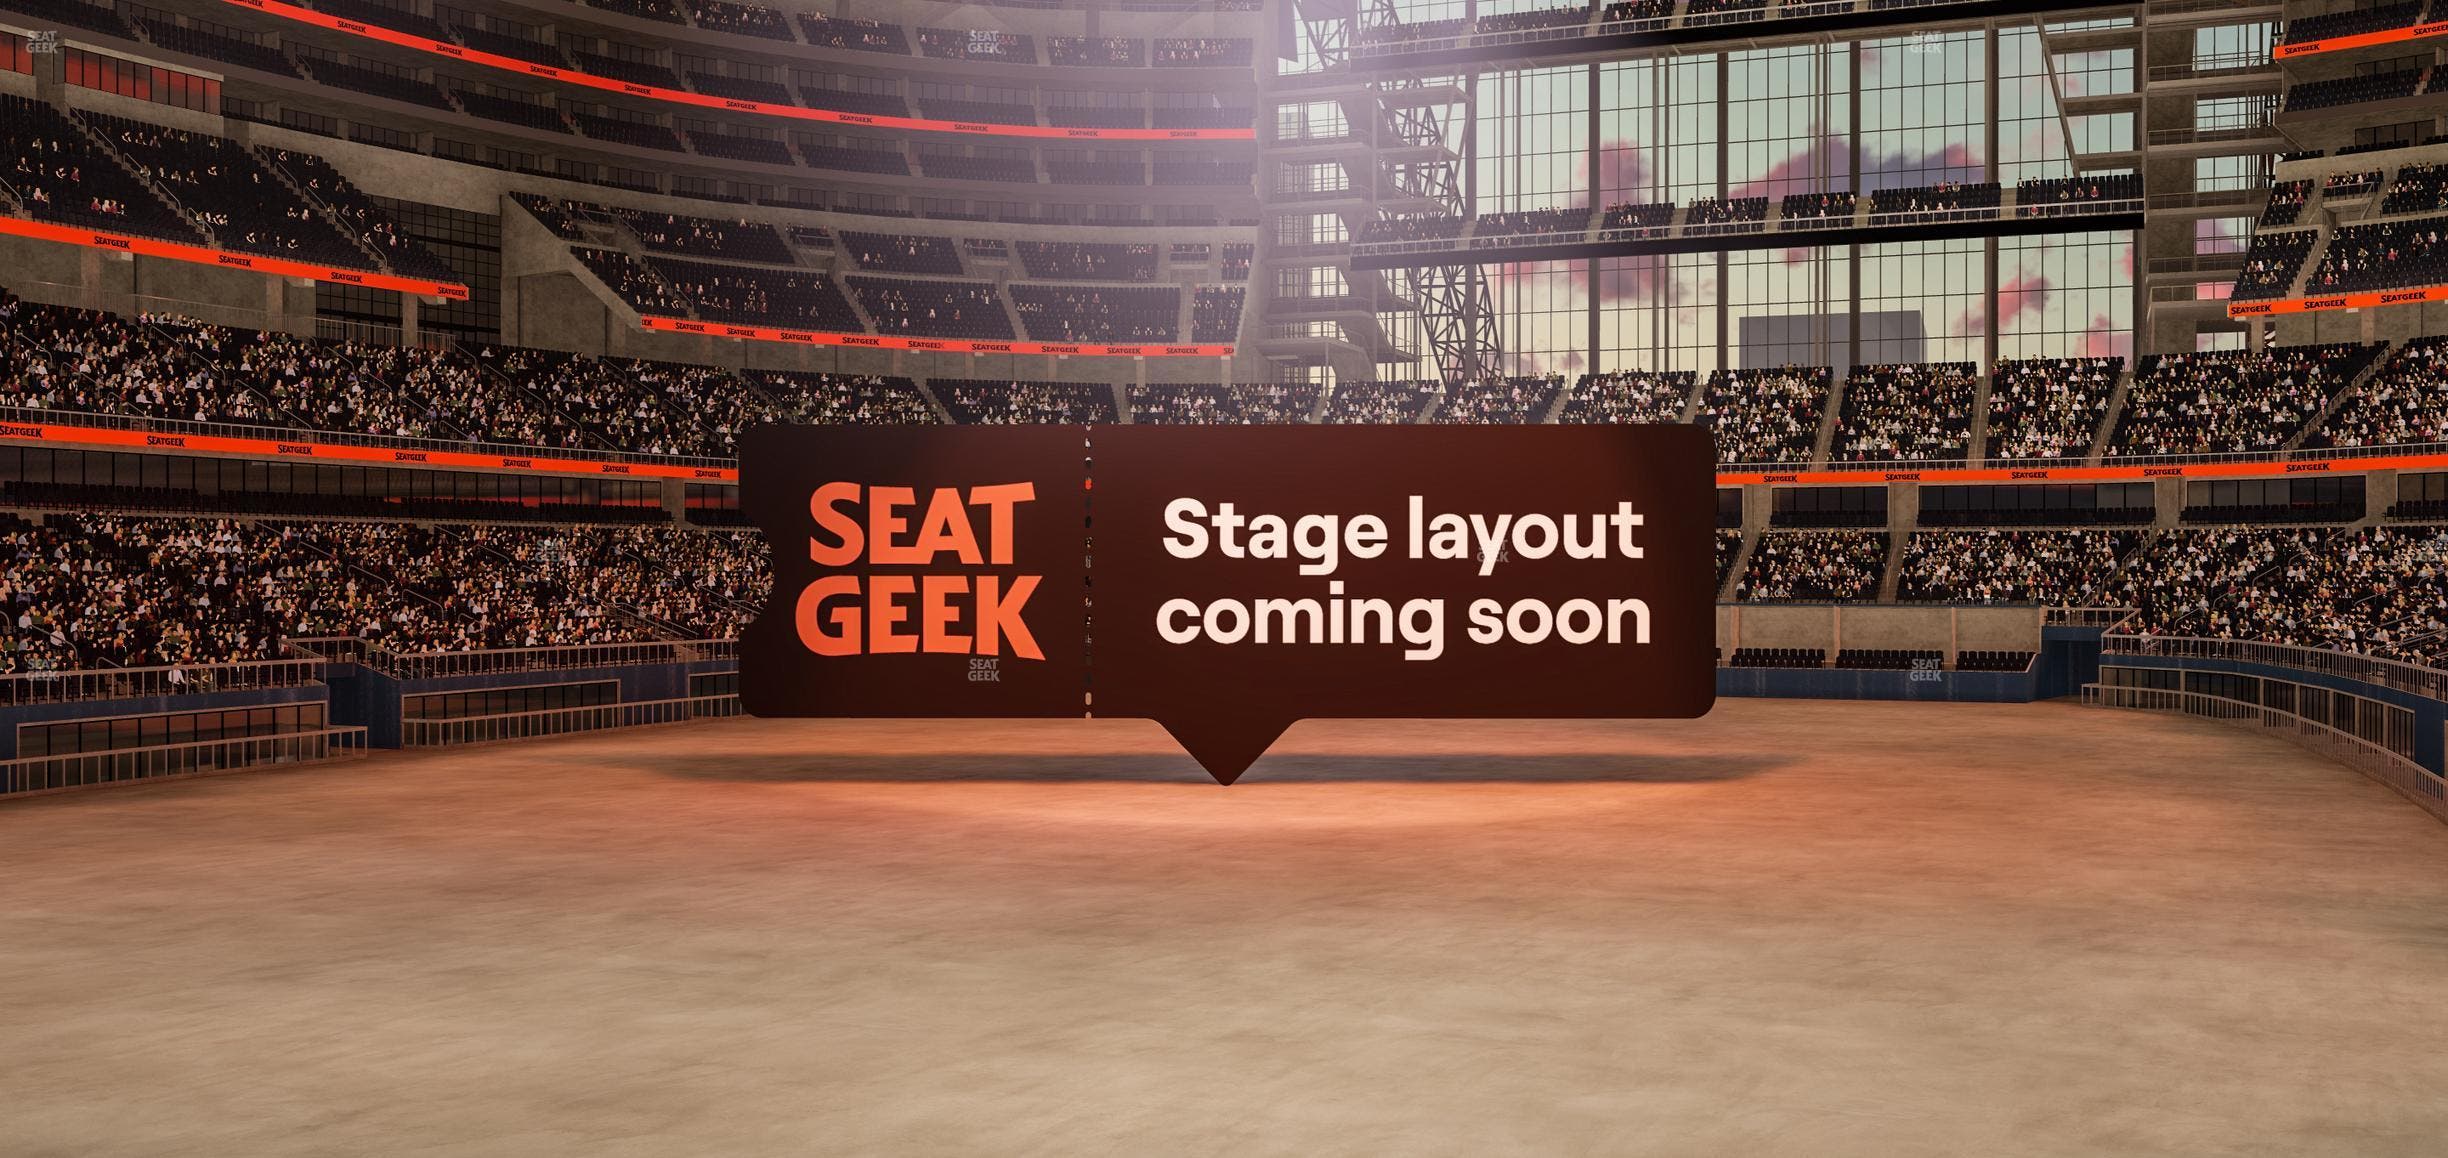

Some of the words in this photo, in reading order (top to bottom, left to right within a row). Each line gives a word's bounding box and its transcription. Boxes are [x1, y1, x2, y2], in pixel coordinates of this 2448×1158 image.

[337, 20, 366, 33] SEATGEEK
[436, 45, 462, 56] SEATGEEK
[2284, 44, 2320, 54] SEATGEEK
[530, 65, 557, 76] SEATGEEK
[624, 84, 651, 95] SEATGEEK
[726, 101, 757, 110] SEATGEEK
[839, 114, 872, 123] SEATGEEK
[94, 236, 129, 249] SEATGEEK
[219, 255, 251, 267] SEATGEEK
[331, 273, 362, 283] SEATGEEK
[438, 287, 466, 298] SEATGEEK
[2381, 292, 2426, 303] SEATGEEK
[2231, 303, 2271, 314] SEATGEEK
[2304, 299, 2346, 310] SEATGEEK
[675, 322, 704, 332] SEATGEEK
[727, 328, 755, 338] SEATGEEK
[780, 332, 812, 342] SEATGEEK
[842, 337, 879, 346] SEATGEEK
[971, 343, 1010, 352] SEATGEEK
[1041, 345, 1079, 354] SEATGEEK
[1107, 347, 1141, 355] SEATGEEK
[147, 434, 184, 447] SEATGEEK
[278, 445, 312, 456] SEATGEEK
[395, 452, 427, 462] SEATGEEK
[503, 459, 531, 469] SEATGEEK
[602, 464, 630, 474] SEATGEEK
[2286, 463, 2330, 473] SEATGEEK
[695, 470, 721, 480] SEATGEEK
[1885, 473, 1920, 481] SEATGEEK
[2011, 471, 2048, 480] SEATGEEK
[2144, 467, 2182, 477] SEATGEEK
[1764, 474, 1797, 483] SEATGEEK
[810, 482, 1035, 565] SEAT
[1162, 497, 1388, 576] Stage
[1409, 495, 1644, 576] layout
[795, 575, 1046, 661] GEEK
[1156, 580, 1444, 661] coming
[1467, 598, 1651, 645] soon
